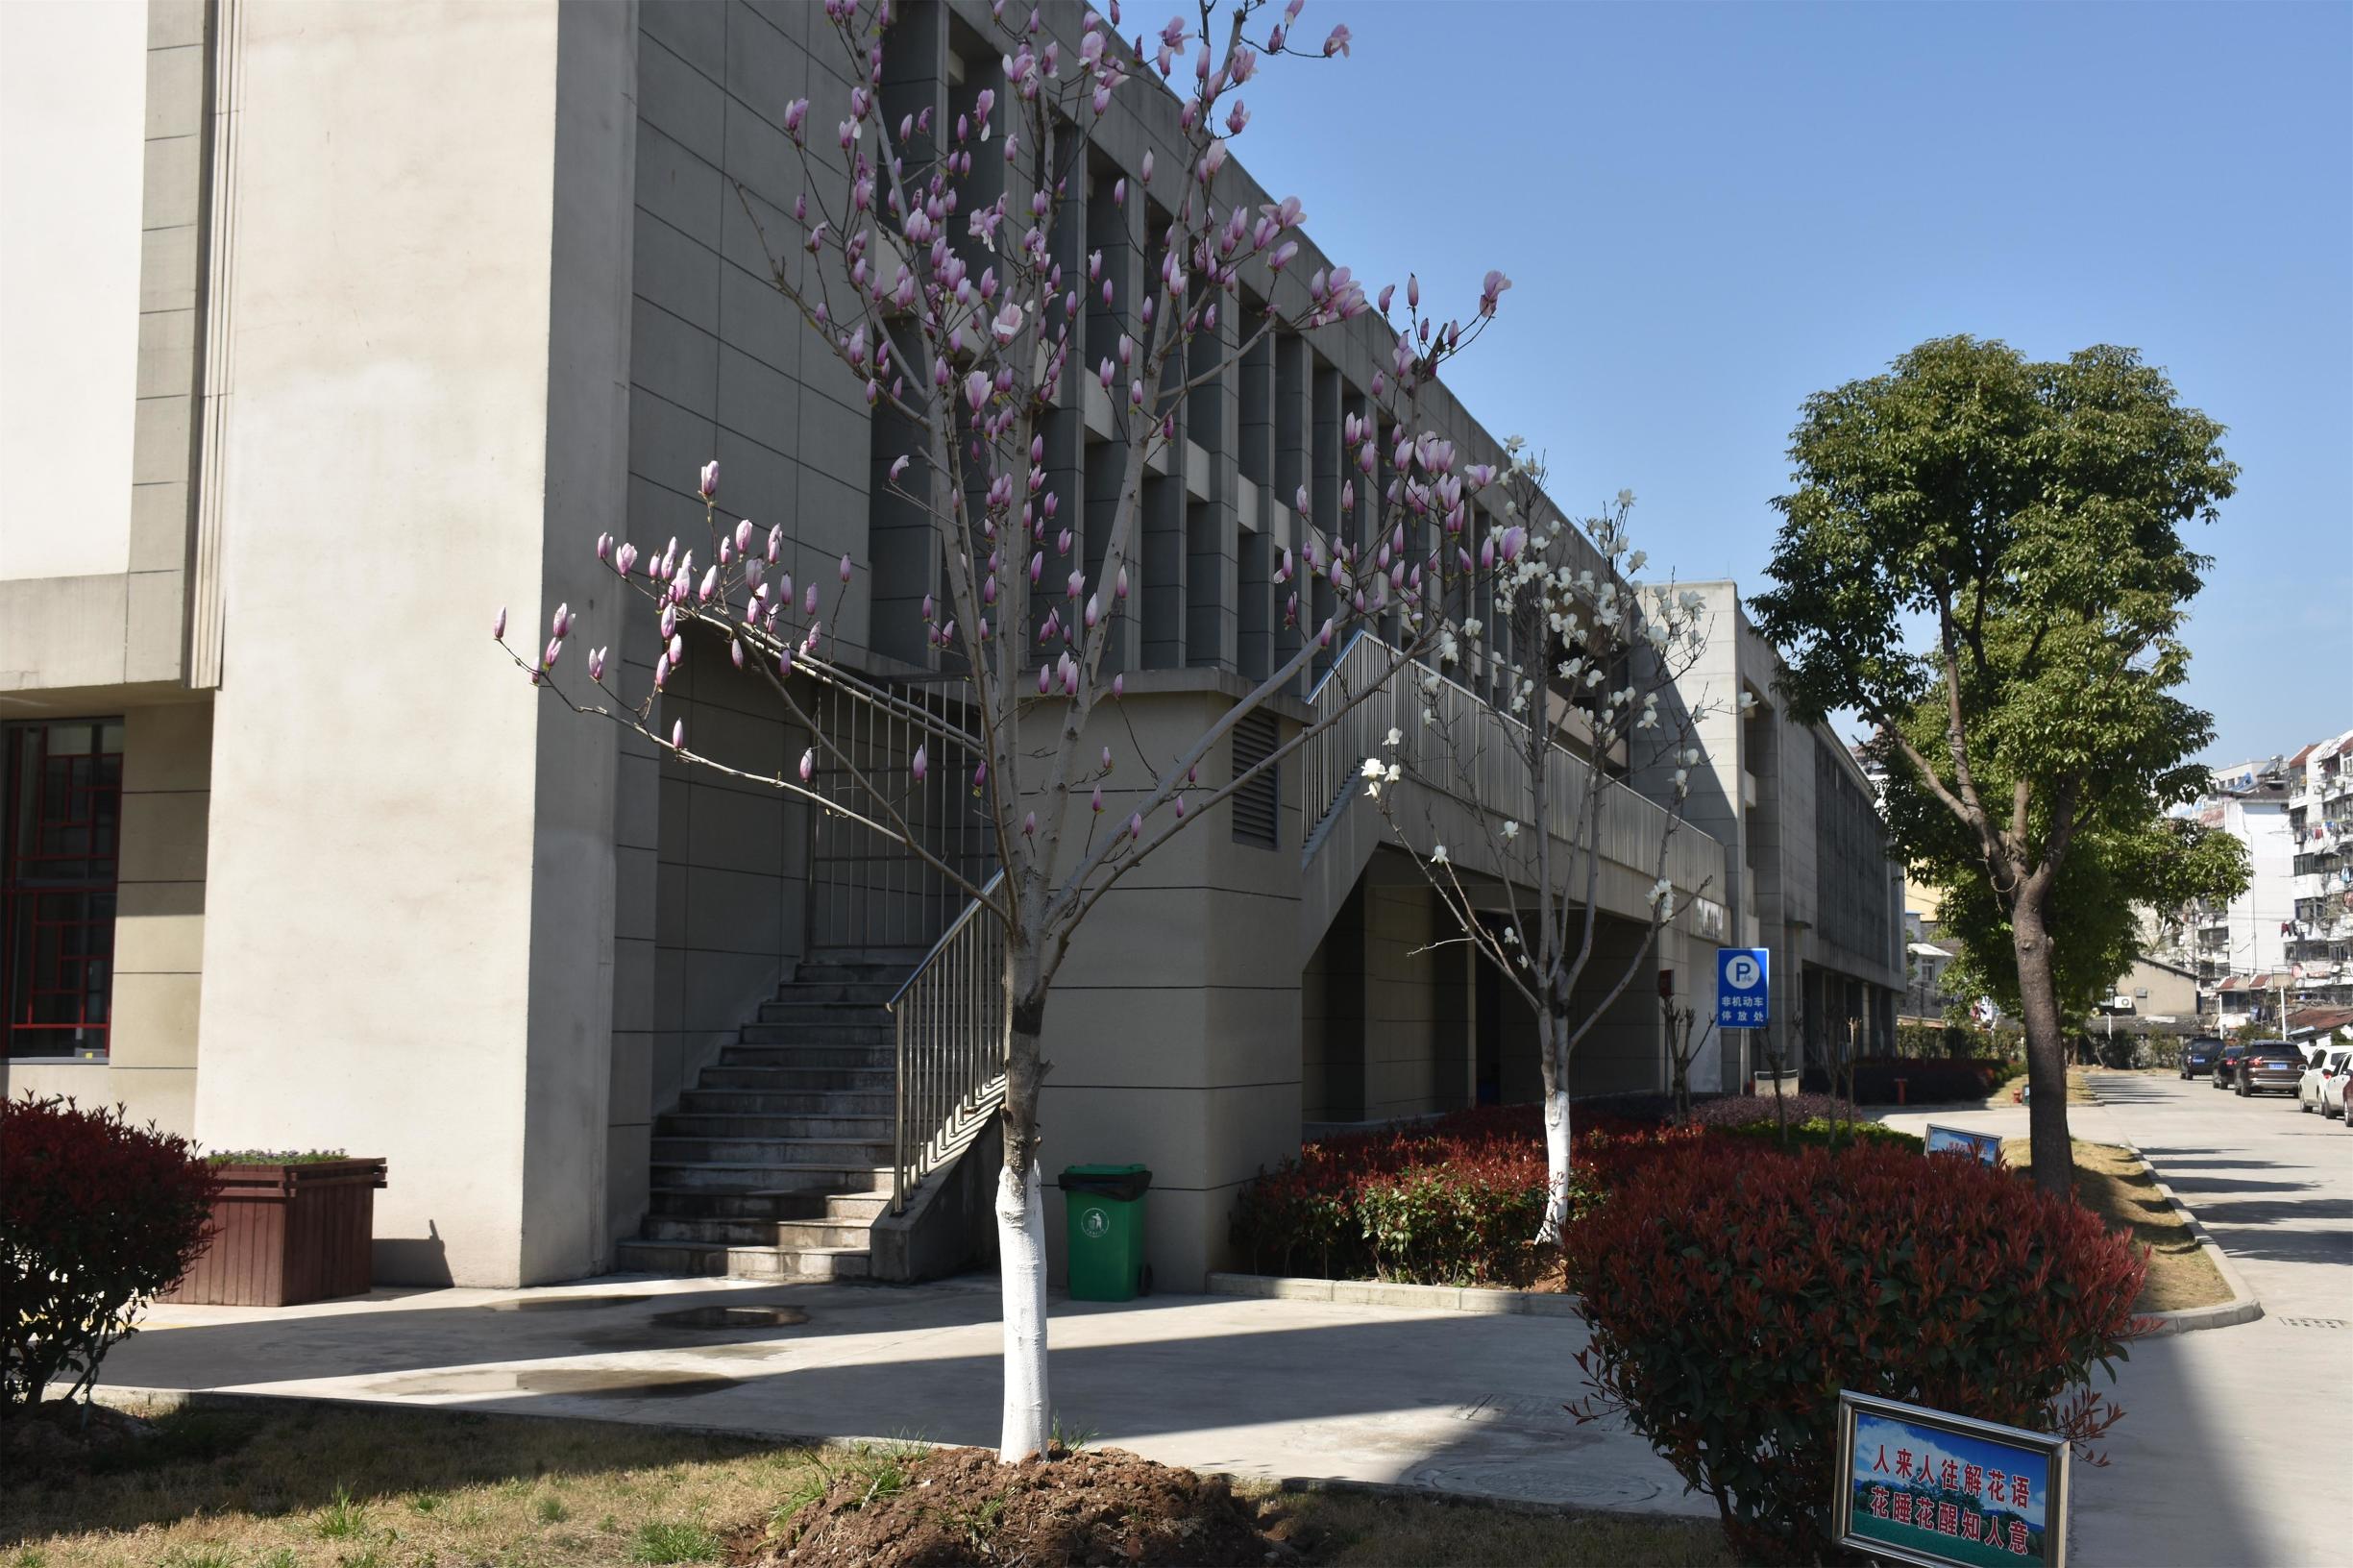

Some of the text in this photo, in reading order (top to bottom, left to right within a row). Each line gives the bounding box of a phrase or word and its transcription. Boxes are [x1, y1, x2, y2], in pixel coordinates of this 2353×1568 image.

[1736, 963, 1751, 981] P
[1722, 996, 1763, 1007] 非机动车
[1722, 1011, 1763, 1021] 停放处
[1873, 1444, 2030, 1509] 人来人往解花语
[1871, 1486, 2029, 1555] 花睡花醒知人意
